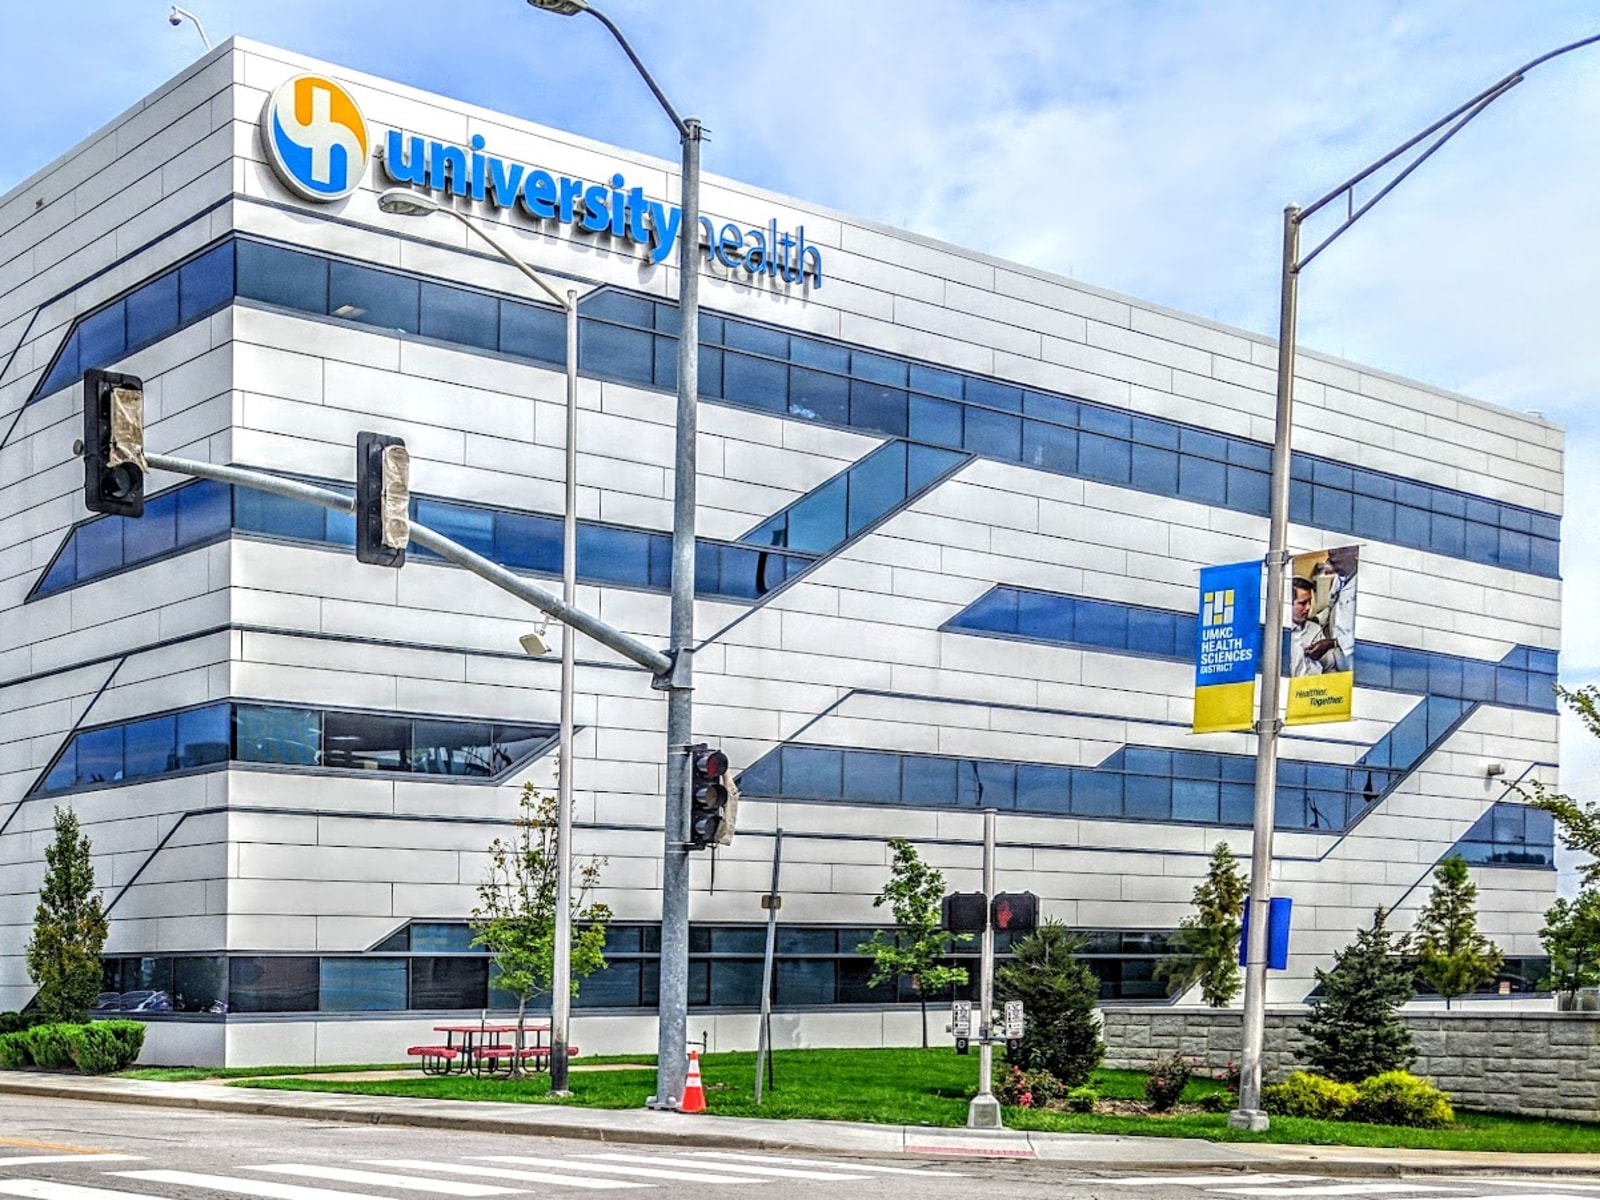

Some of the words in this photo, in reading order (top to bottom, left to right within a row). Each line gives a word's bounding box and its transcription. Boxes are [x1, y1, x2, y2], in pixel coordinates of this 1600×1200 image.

[385, 129, 683, 265] university
[1202, 627, 1234, 641] UMKC
[1201, 638, 1243, 653] HEALTH
[1200, 648, 1253, 665] SCIENCES
[1200, 663, 1234, 675] DISTRICT
